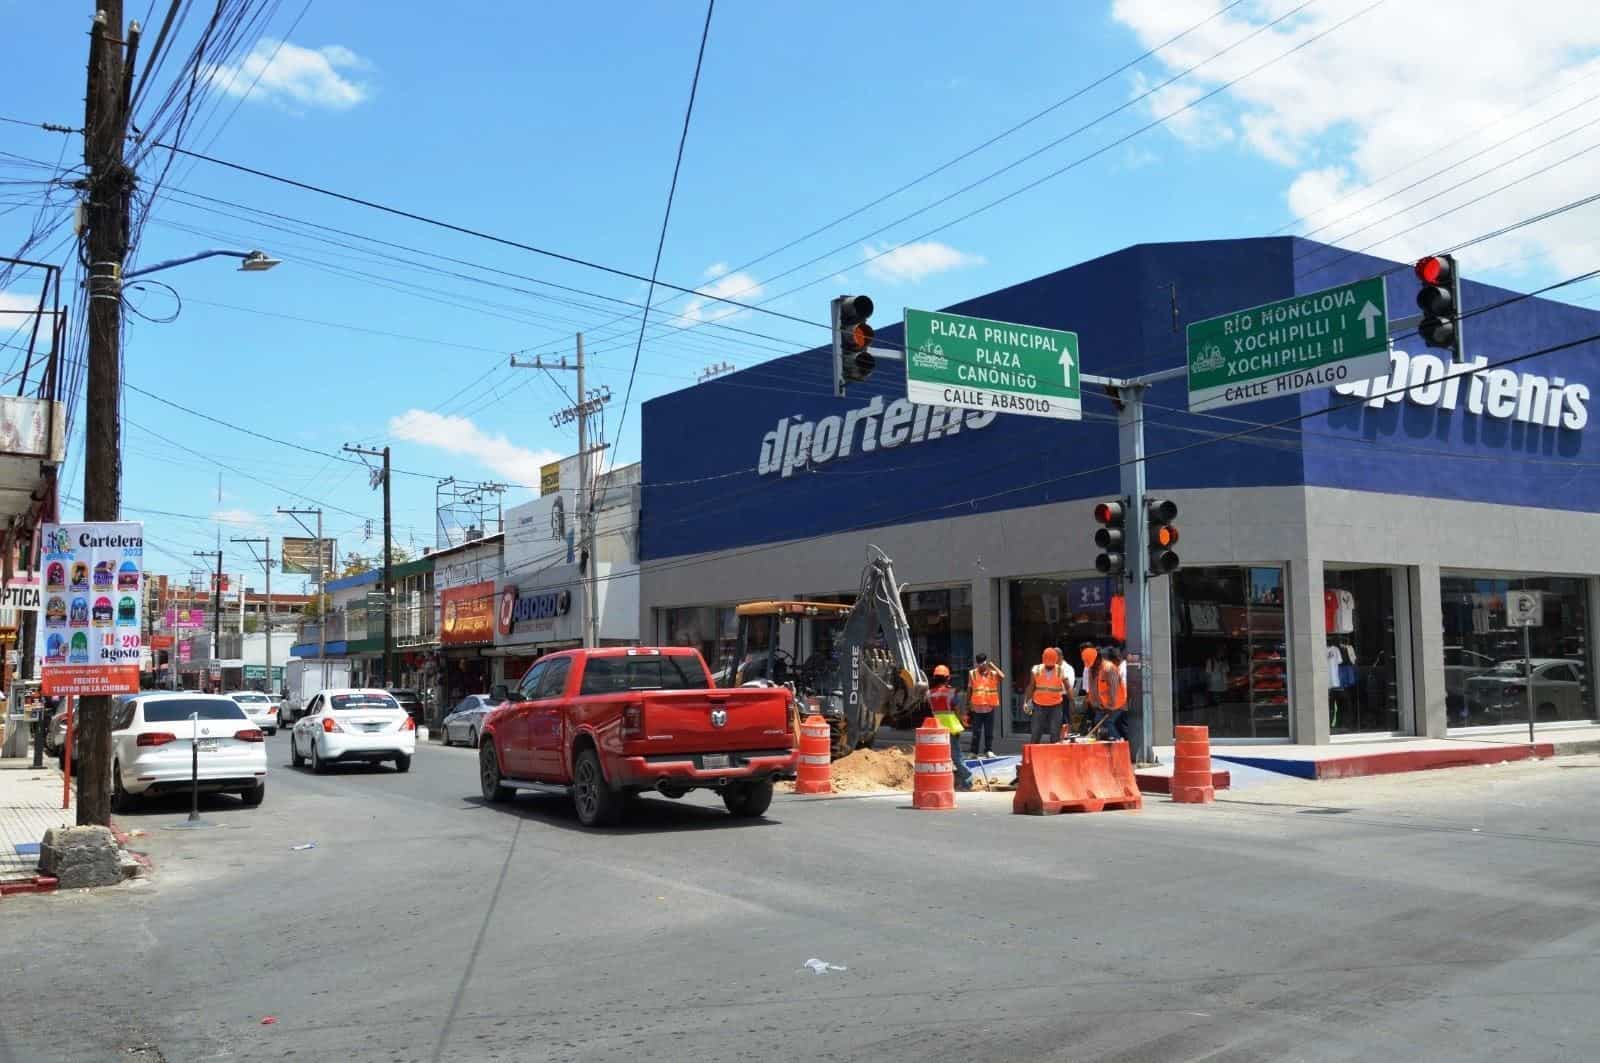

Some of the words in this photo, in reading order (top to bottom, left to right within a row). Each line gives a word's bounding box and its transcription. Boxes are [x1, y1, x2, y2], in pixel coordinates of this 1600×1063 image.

[1224, 314, 1253, 336] RÍO
[1261, 290, 1356, 324] MONCLOVA
[931, 319, 977, 341] PLAZA
[984, 328, 1058, 352] PRINCIPAL
[1234, 318, 1329, 354] XOCHIPILLI
[1341, 314, 1347, 330] I
[976, 348, 1021, 368] PLAZA
[1227, 342, 1321, 377] XOCHIPILLI
[1332, 338, 1344, 354] II
[958, 365, 1037, 389] CANÓNIGO
[1224, 382, 1268, 402] CALLE
[1276, 365, 1347, 392] HIDALGO
[943, 389, 984, 406] CALLE
[991, 395, 1050, 413] ABASOLO
[79, 532, 143, 548] Cartelera
[0, 588, 40, 607] PTICA
[122, 635, 140, 648] 20
[101, 647, 140, 662] agosto
[849, 644, 860, 705] DEERE
